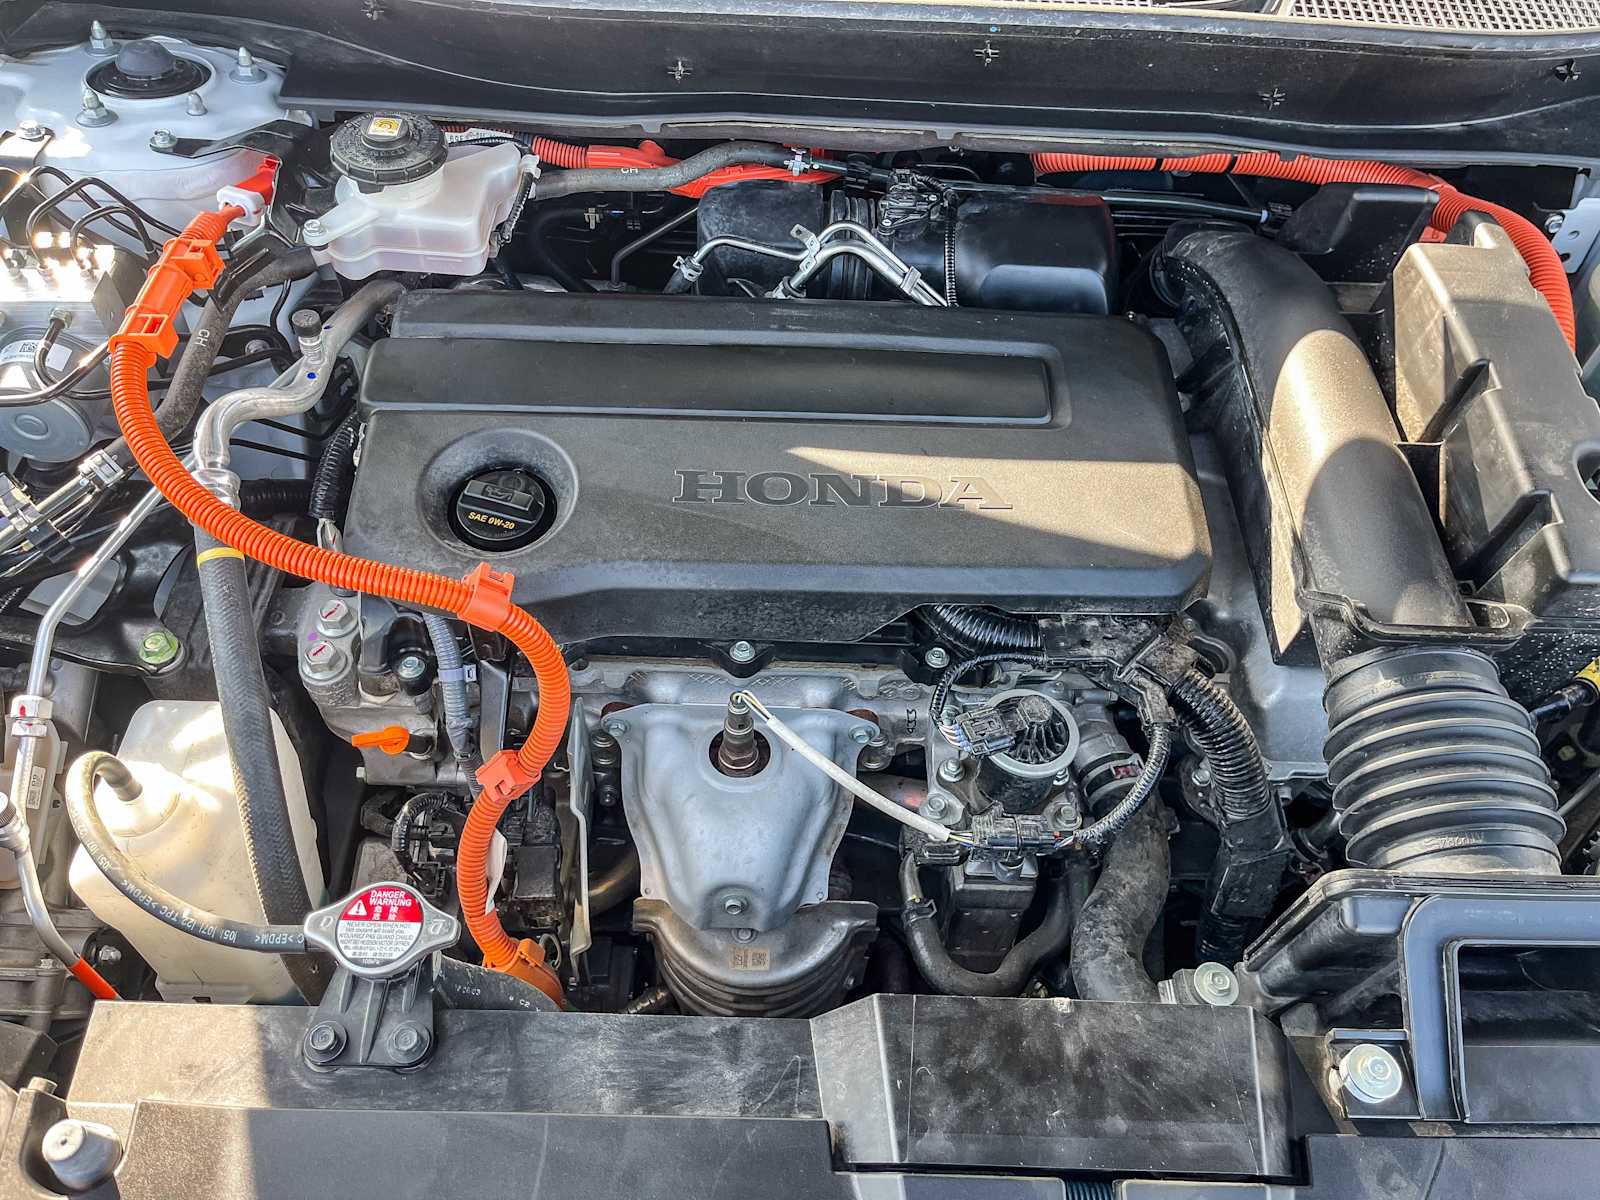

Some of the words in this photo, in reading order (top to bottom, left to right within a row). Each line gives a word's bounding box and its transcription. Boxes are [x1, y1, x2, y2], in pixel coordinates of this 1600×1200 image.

[673, 470, 1012, 509] HONDA
[468, 512, 488, 523] SAE
[488, 517, 515, 529] 0W-20
[369, 897, 412, 906] WARNUNG
[371, 890, 405, 899] DANGER
[160, 906, 179, 922] TPC
